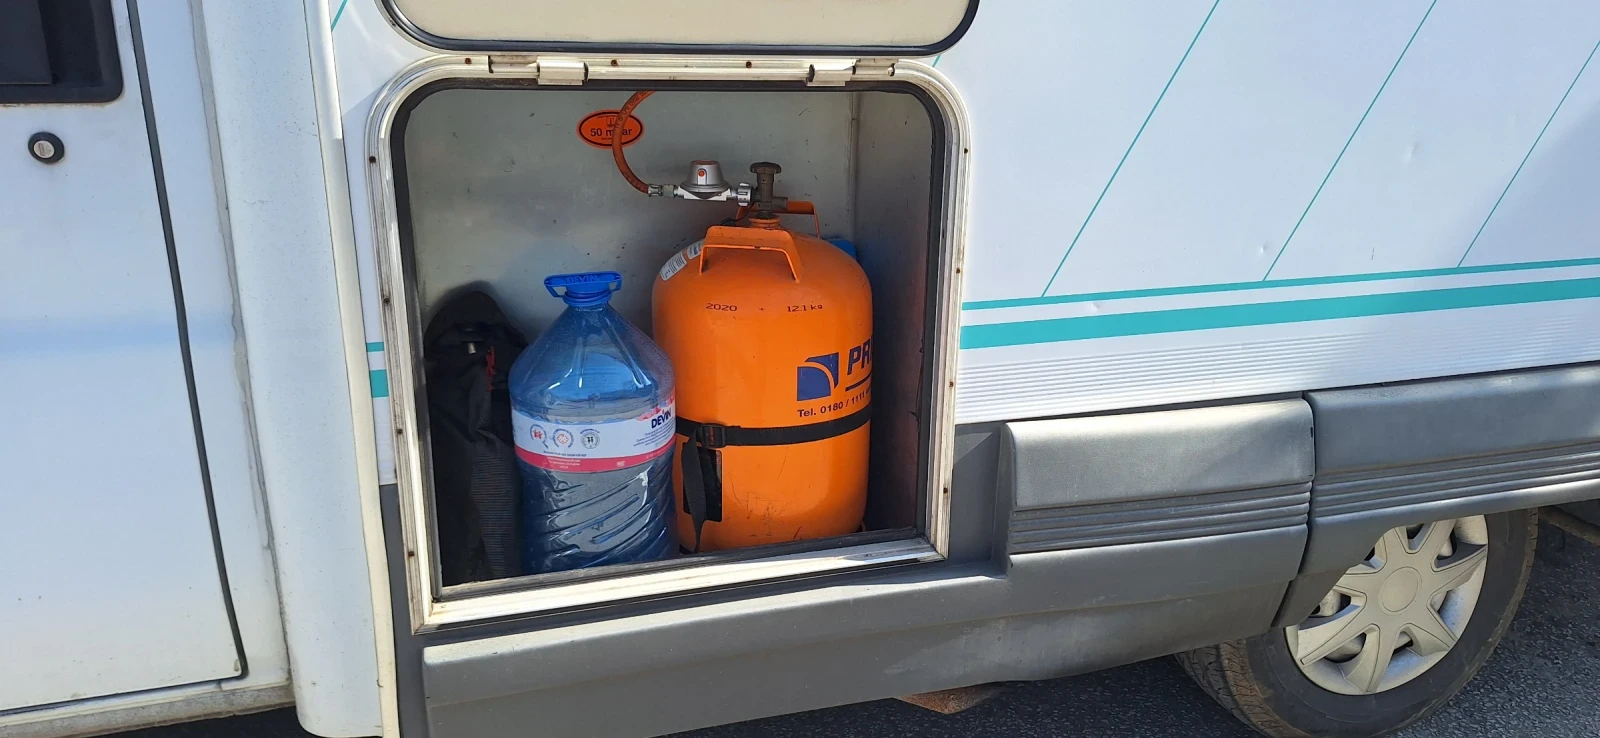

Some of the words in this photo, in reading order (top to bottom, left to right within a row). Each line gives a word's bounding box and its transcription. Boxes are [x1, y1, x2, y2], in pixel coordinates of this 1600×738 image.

[590, 128, 603, 137] 50
[606, 127, 633, 136] mar
[706, 303, 738, 312] 2020
[797, 408, 817, 417] Tel.
[820, 401, 844, 414] 0180
[651, 407, 672, 429] DEVIN
